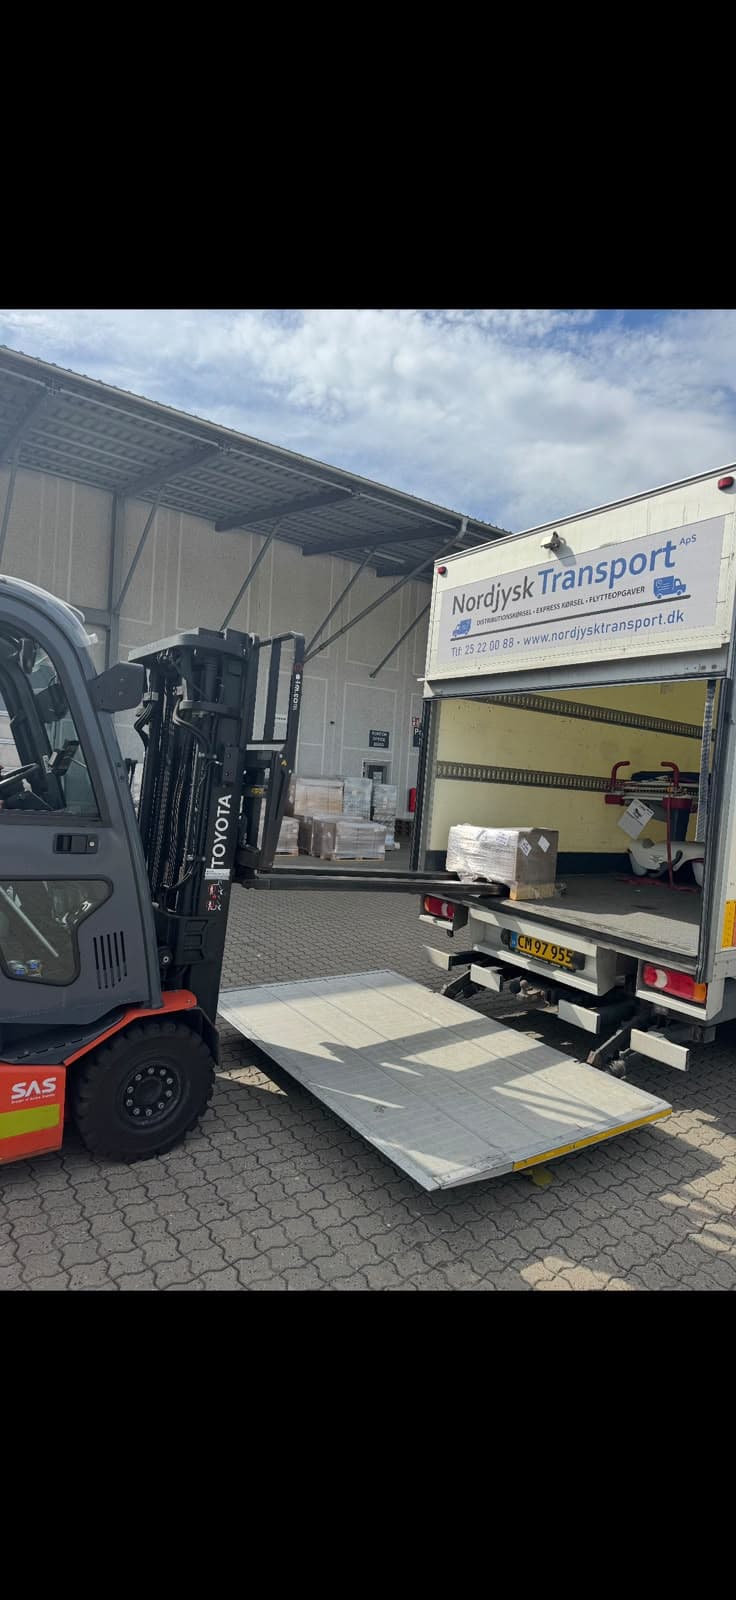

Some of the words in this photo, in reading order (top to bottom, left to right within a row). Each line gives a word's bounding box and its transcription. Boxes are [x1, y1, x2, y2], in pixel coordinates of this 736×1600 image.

[452, 576, 535, 615] Nordjysk
[538, 541, 677, 595] Transport
[679, 534, 697, 546] ApS
[476, 609, 532, 626] DISTRIBUTIONSKØRSEL
[535, 601, 561, 614] EXPRESS
[561, 598, 585, 609] KØRSEL
[589, 586, 645, 603] FLYTTEOPGAVER
[464, 643, 475, 655] 25
[477, 642, 487, 653] 22
[489, 640, 500, 652] 00
[502, 637, 514, 649] 88
[523, 609, 684, 646] www.nordjysktransport.dk
[211, 794, 232, 869] TOYOTA
[518, 935, 532, 951] CM
[535, 940, 549, 955] 97
[551, 945, 573, 964] 955
[11, 1076, 57, 1100] SAS
